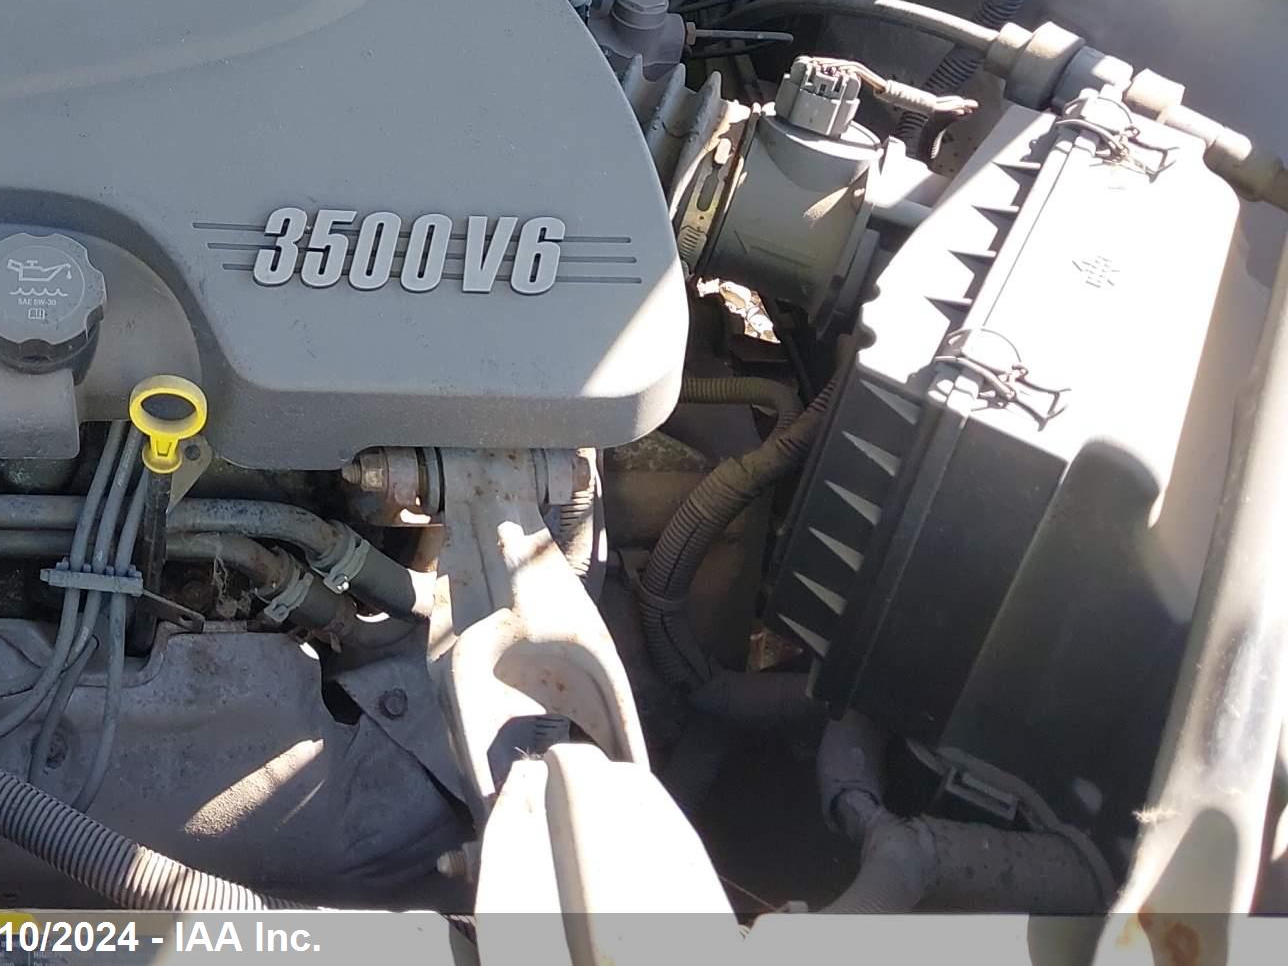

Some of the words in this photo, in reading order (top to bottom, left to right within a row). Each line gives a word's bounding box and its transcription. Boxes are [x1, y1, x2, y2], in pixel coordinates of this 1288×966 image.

[253, 207, 452, 292] 3500
[461, 216, 566, 295] V6
[33, 298, 57, 306] 5W-30
